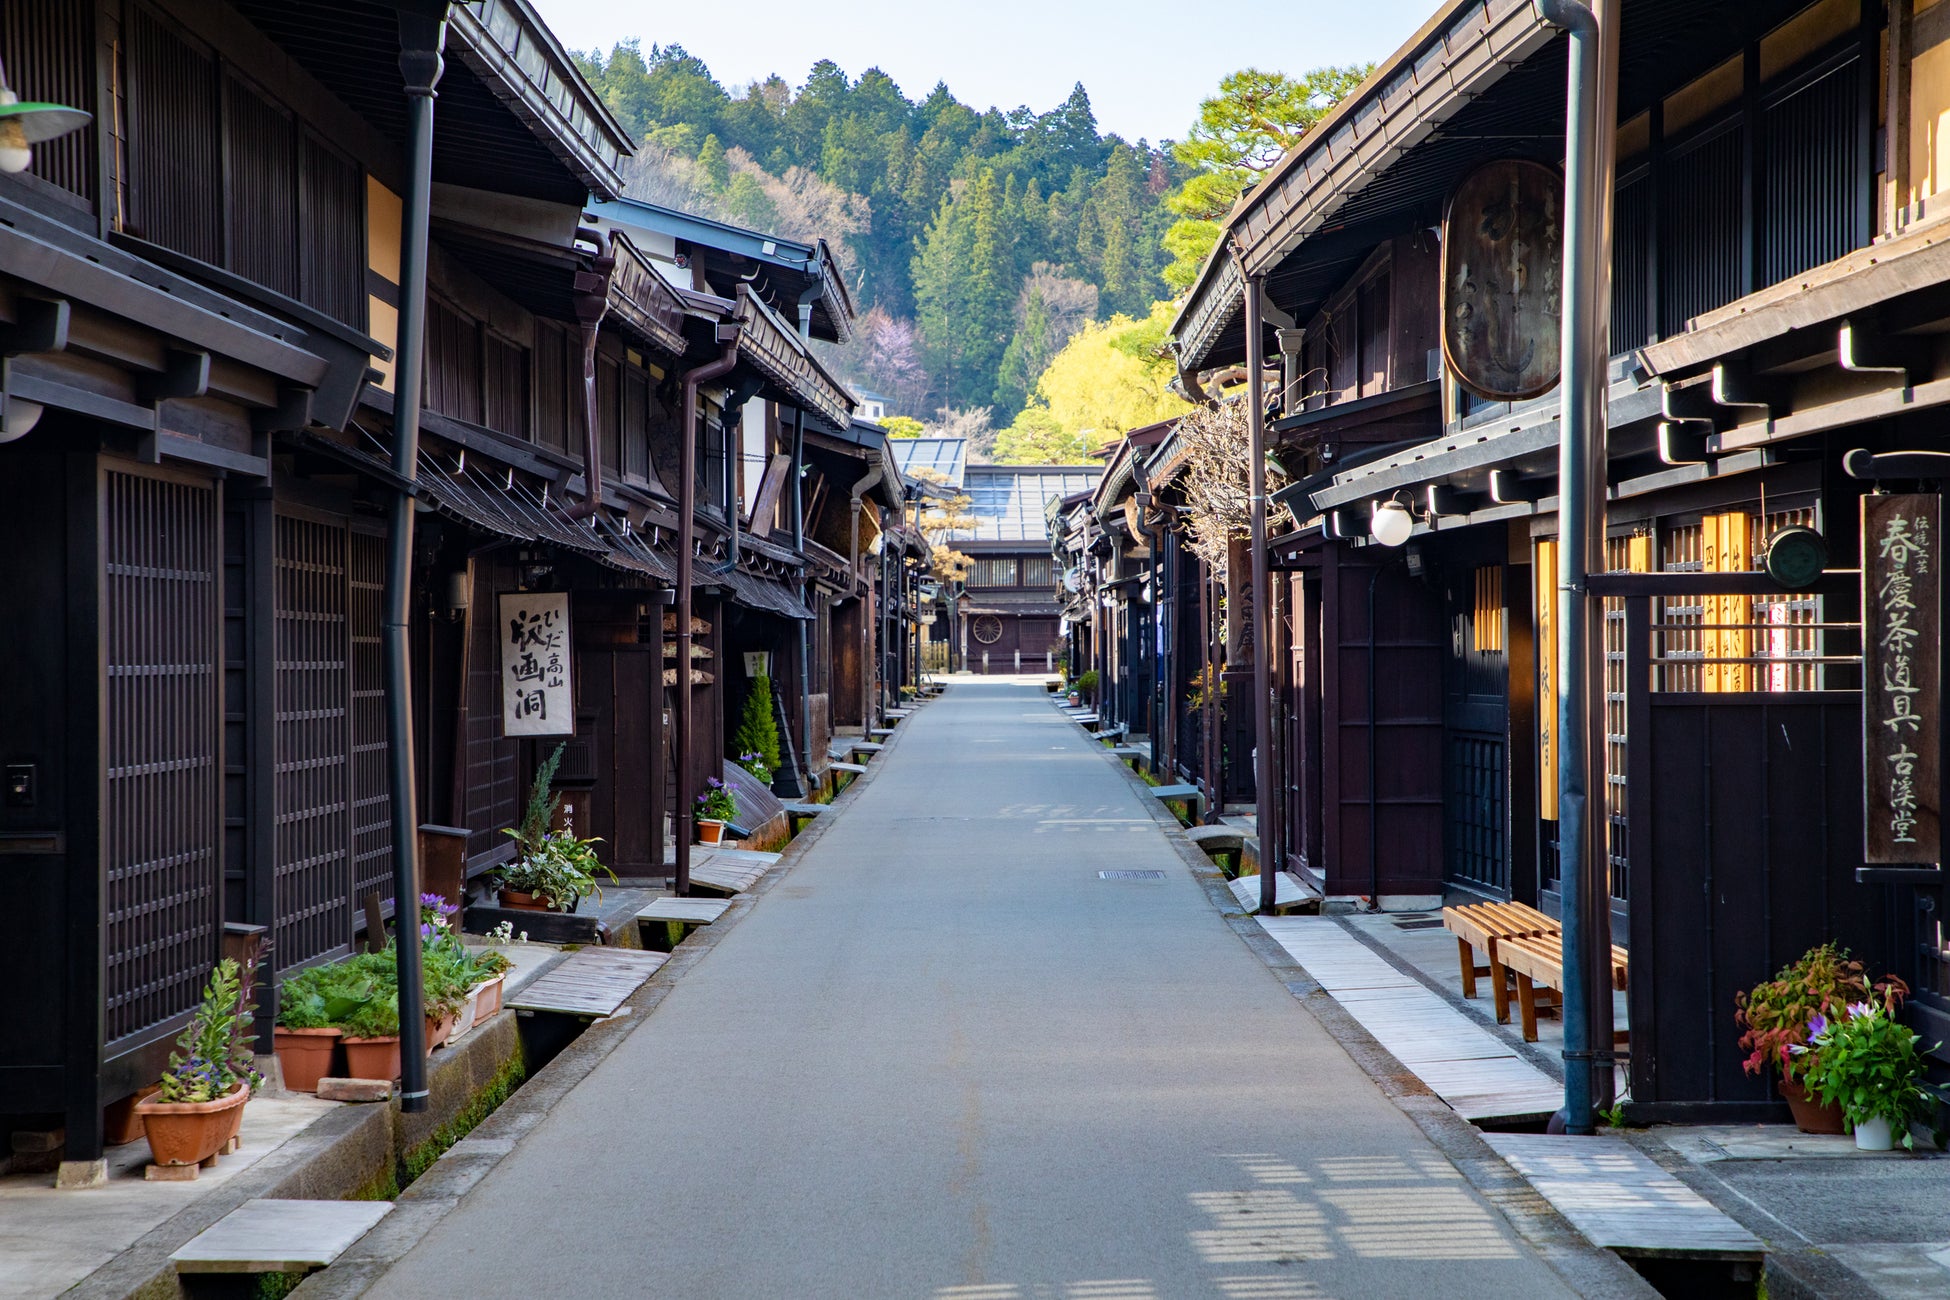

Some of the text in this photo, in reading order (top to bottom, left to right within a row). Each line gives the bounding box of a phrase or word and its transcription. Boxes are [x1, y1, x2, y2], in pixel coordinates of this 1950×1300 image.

[1913, 516, 1930, 574] 伝統工芸
[511, 610, 547, 720] 版画洞
[544, 610, 563, 687] ひだ高山
